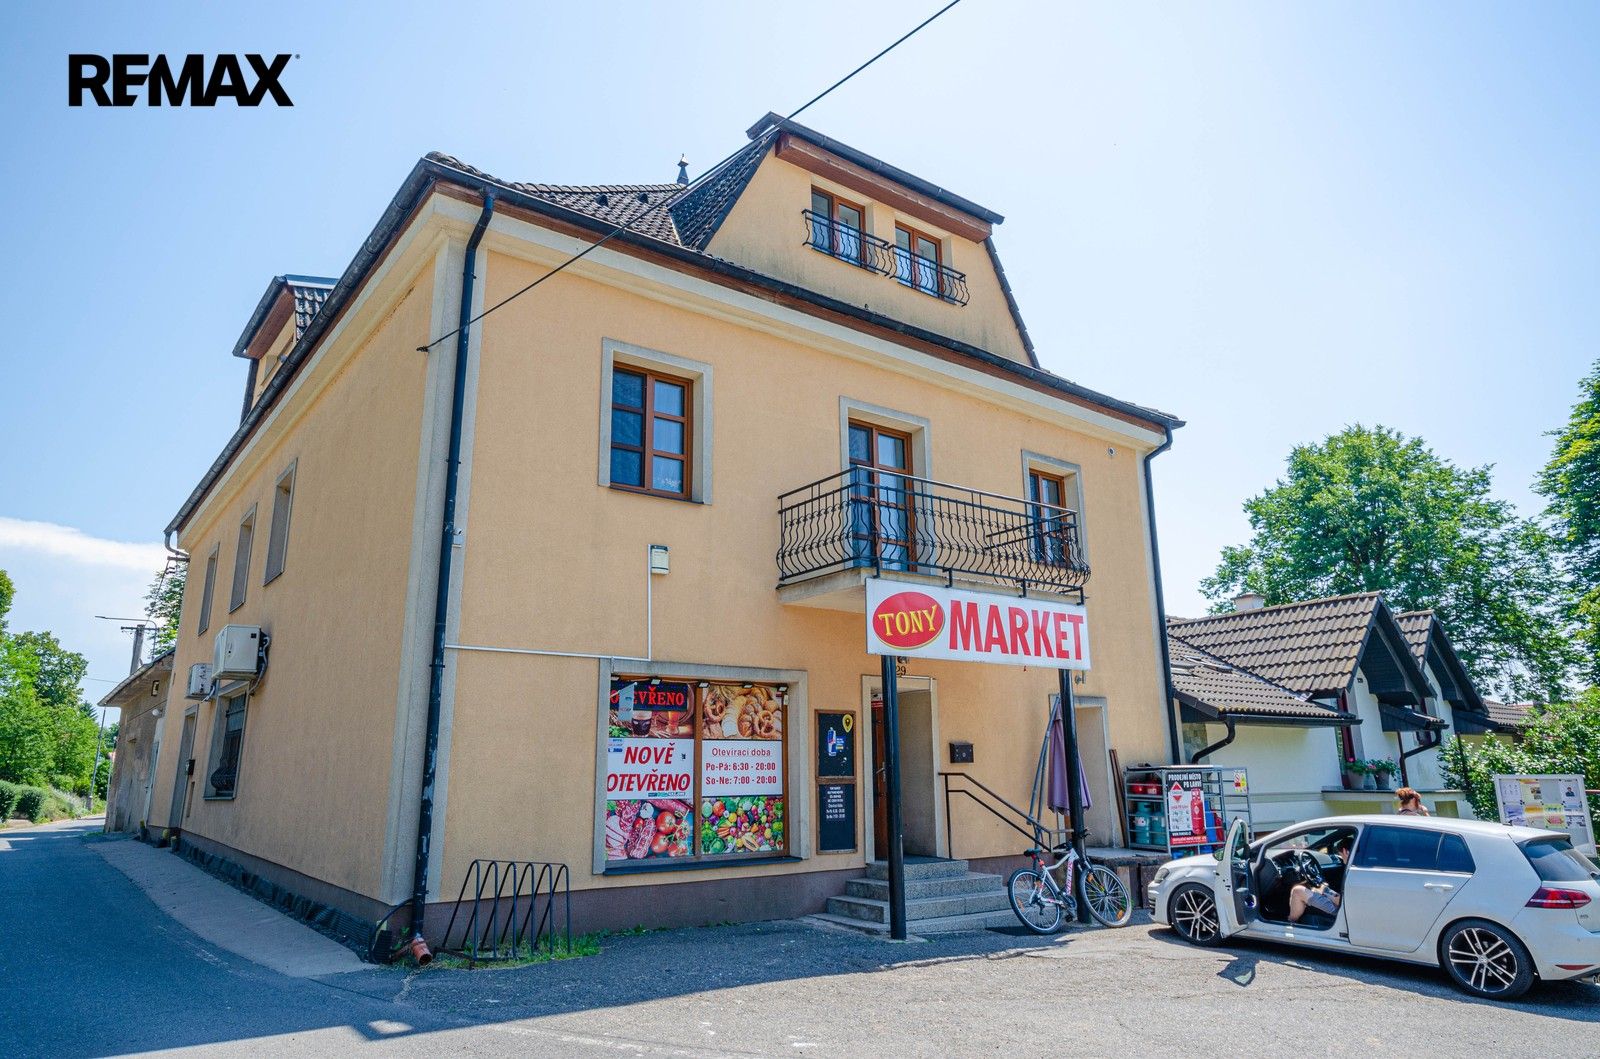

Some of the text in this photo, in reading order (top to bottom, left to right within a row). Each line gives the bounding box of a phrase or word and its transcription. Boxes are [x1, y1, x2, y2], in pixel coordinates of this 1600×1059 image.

[878, 600, 1084, 660] TONY MARKET
[624, 742, 675, 764] NOVĚ
[751, 748, 771, 756] doba
[732, 762, 749, 771] 6:30
[755, 762, 776, 771] 20:00
[607, 769, 690, 792] OTEVŘENO
[733, 776, 750, 784] 7:00
[756, 776, 777, 784] 20:00
